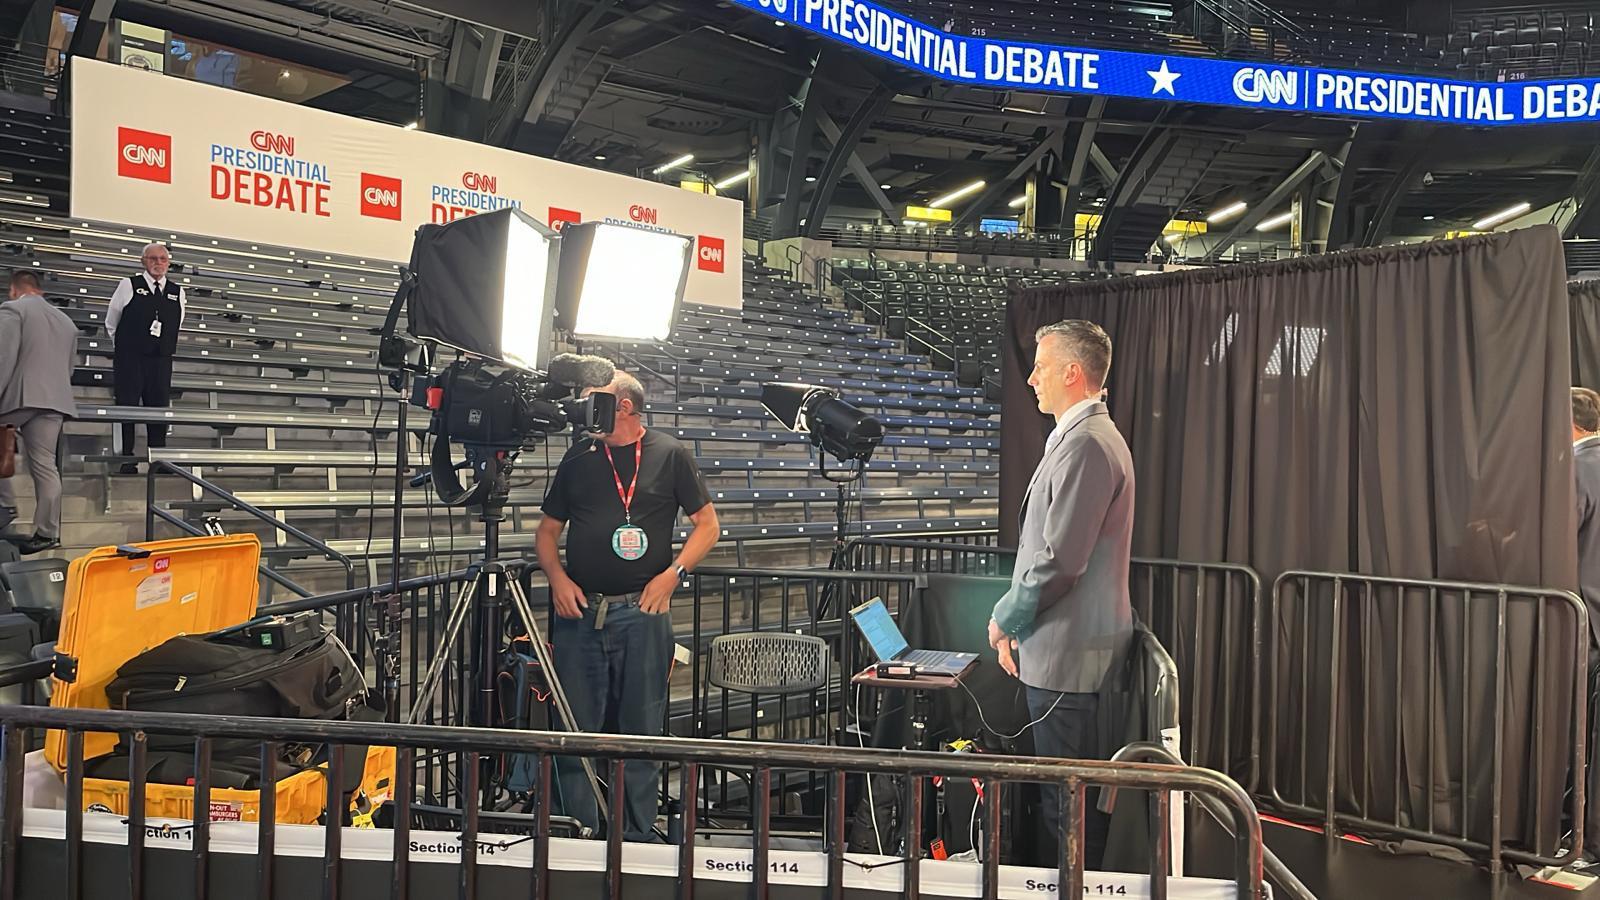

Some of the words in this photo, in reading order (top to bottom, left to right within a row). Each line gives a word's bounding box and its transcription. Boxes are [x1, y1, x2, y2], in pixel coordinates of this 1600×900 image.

[972, 28, 986, 36] 215
[805, 0, 977, 79] PRESIDENTIAL
[984, 44, 1100, 89] DEBATE
[1232, 67, 1297, 105] CNN
[1316, 74, 1514, 121] PRESIDENTIAL
[250, 130, 294, 156] CNN
[123, 143, 166, 169] CNN
[211, 143, 331, 183] PRESIDENTIAL
[210, 165, 331, 217] DEBATE
[462, 171, 497, 194] CNN
[364, 187, 397, 208] CNN
[629, 205, 657, 224] CNN
[700, 246, 722, 263] CNN
[146, 829, 180, 839] ction
[478, 843, 495, 855] 14
[705, 859, 753, 872] Sectio
[770, 862, 798, 873] 114
[1096, 884, 1126, 896] 114
